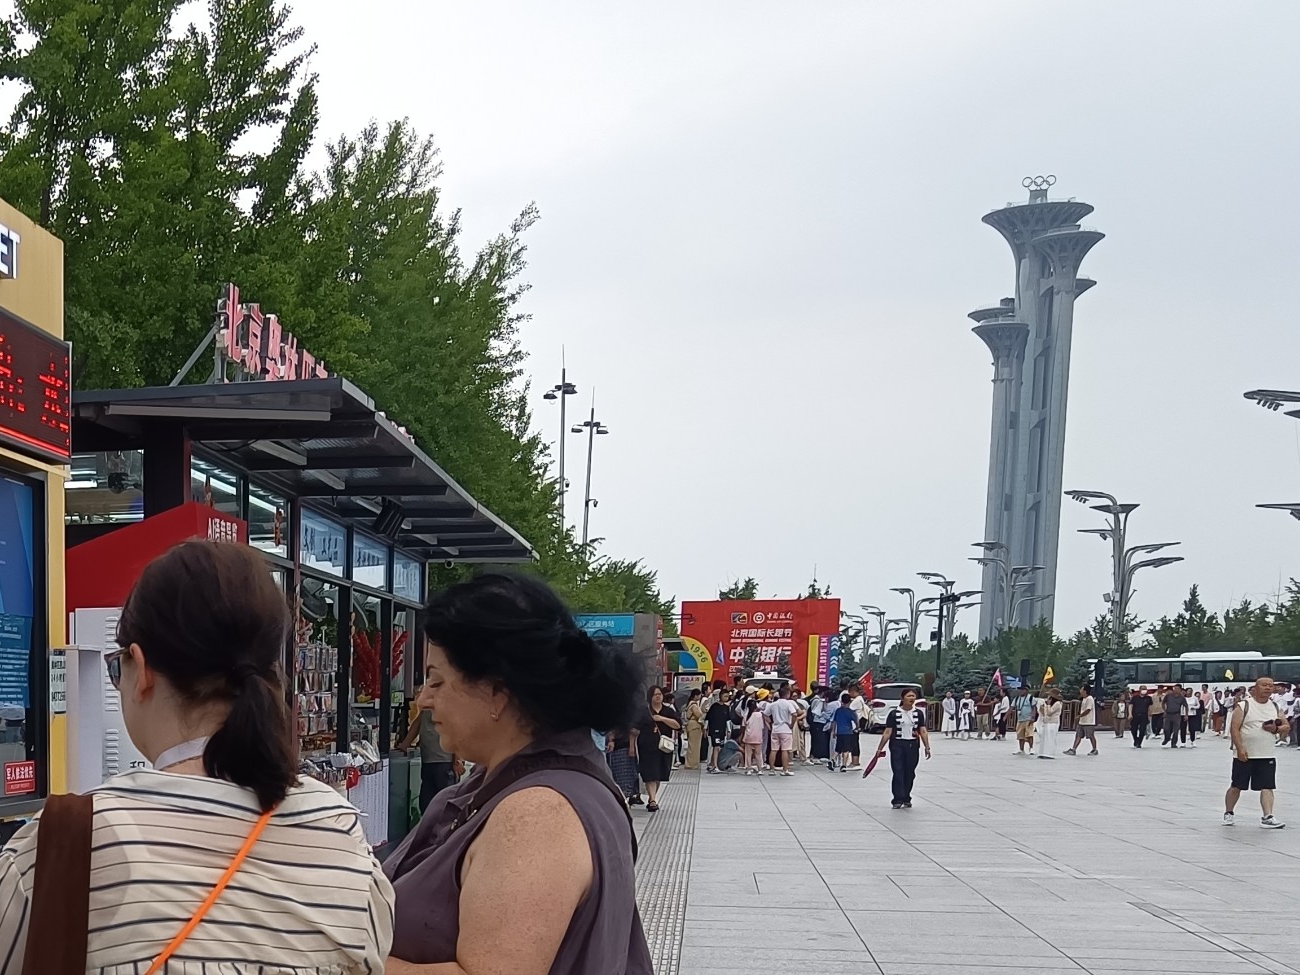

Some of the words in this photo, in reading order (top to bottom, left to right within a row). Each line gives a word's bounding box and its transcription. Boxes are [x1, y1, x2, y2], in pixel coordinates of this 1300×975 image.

[730, 628, 793, 638] 北京国际长跑节
[690, 643, 709, 663] 1956
